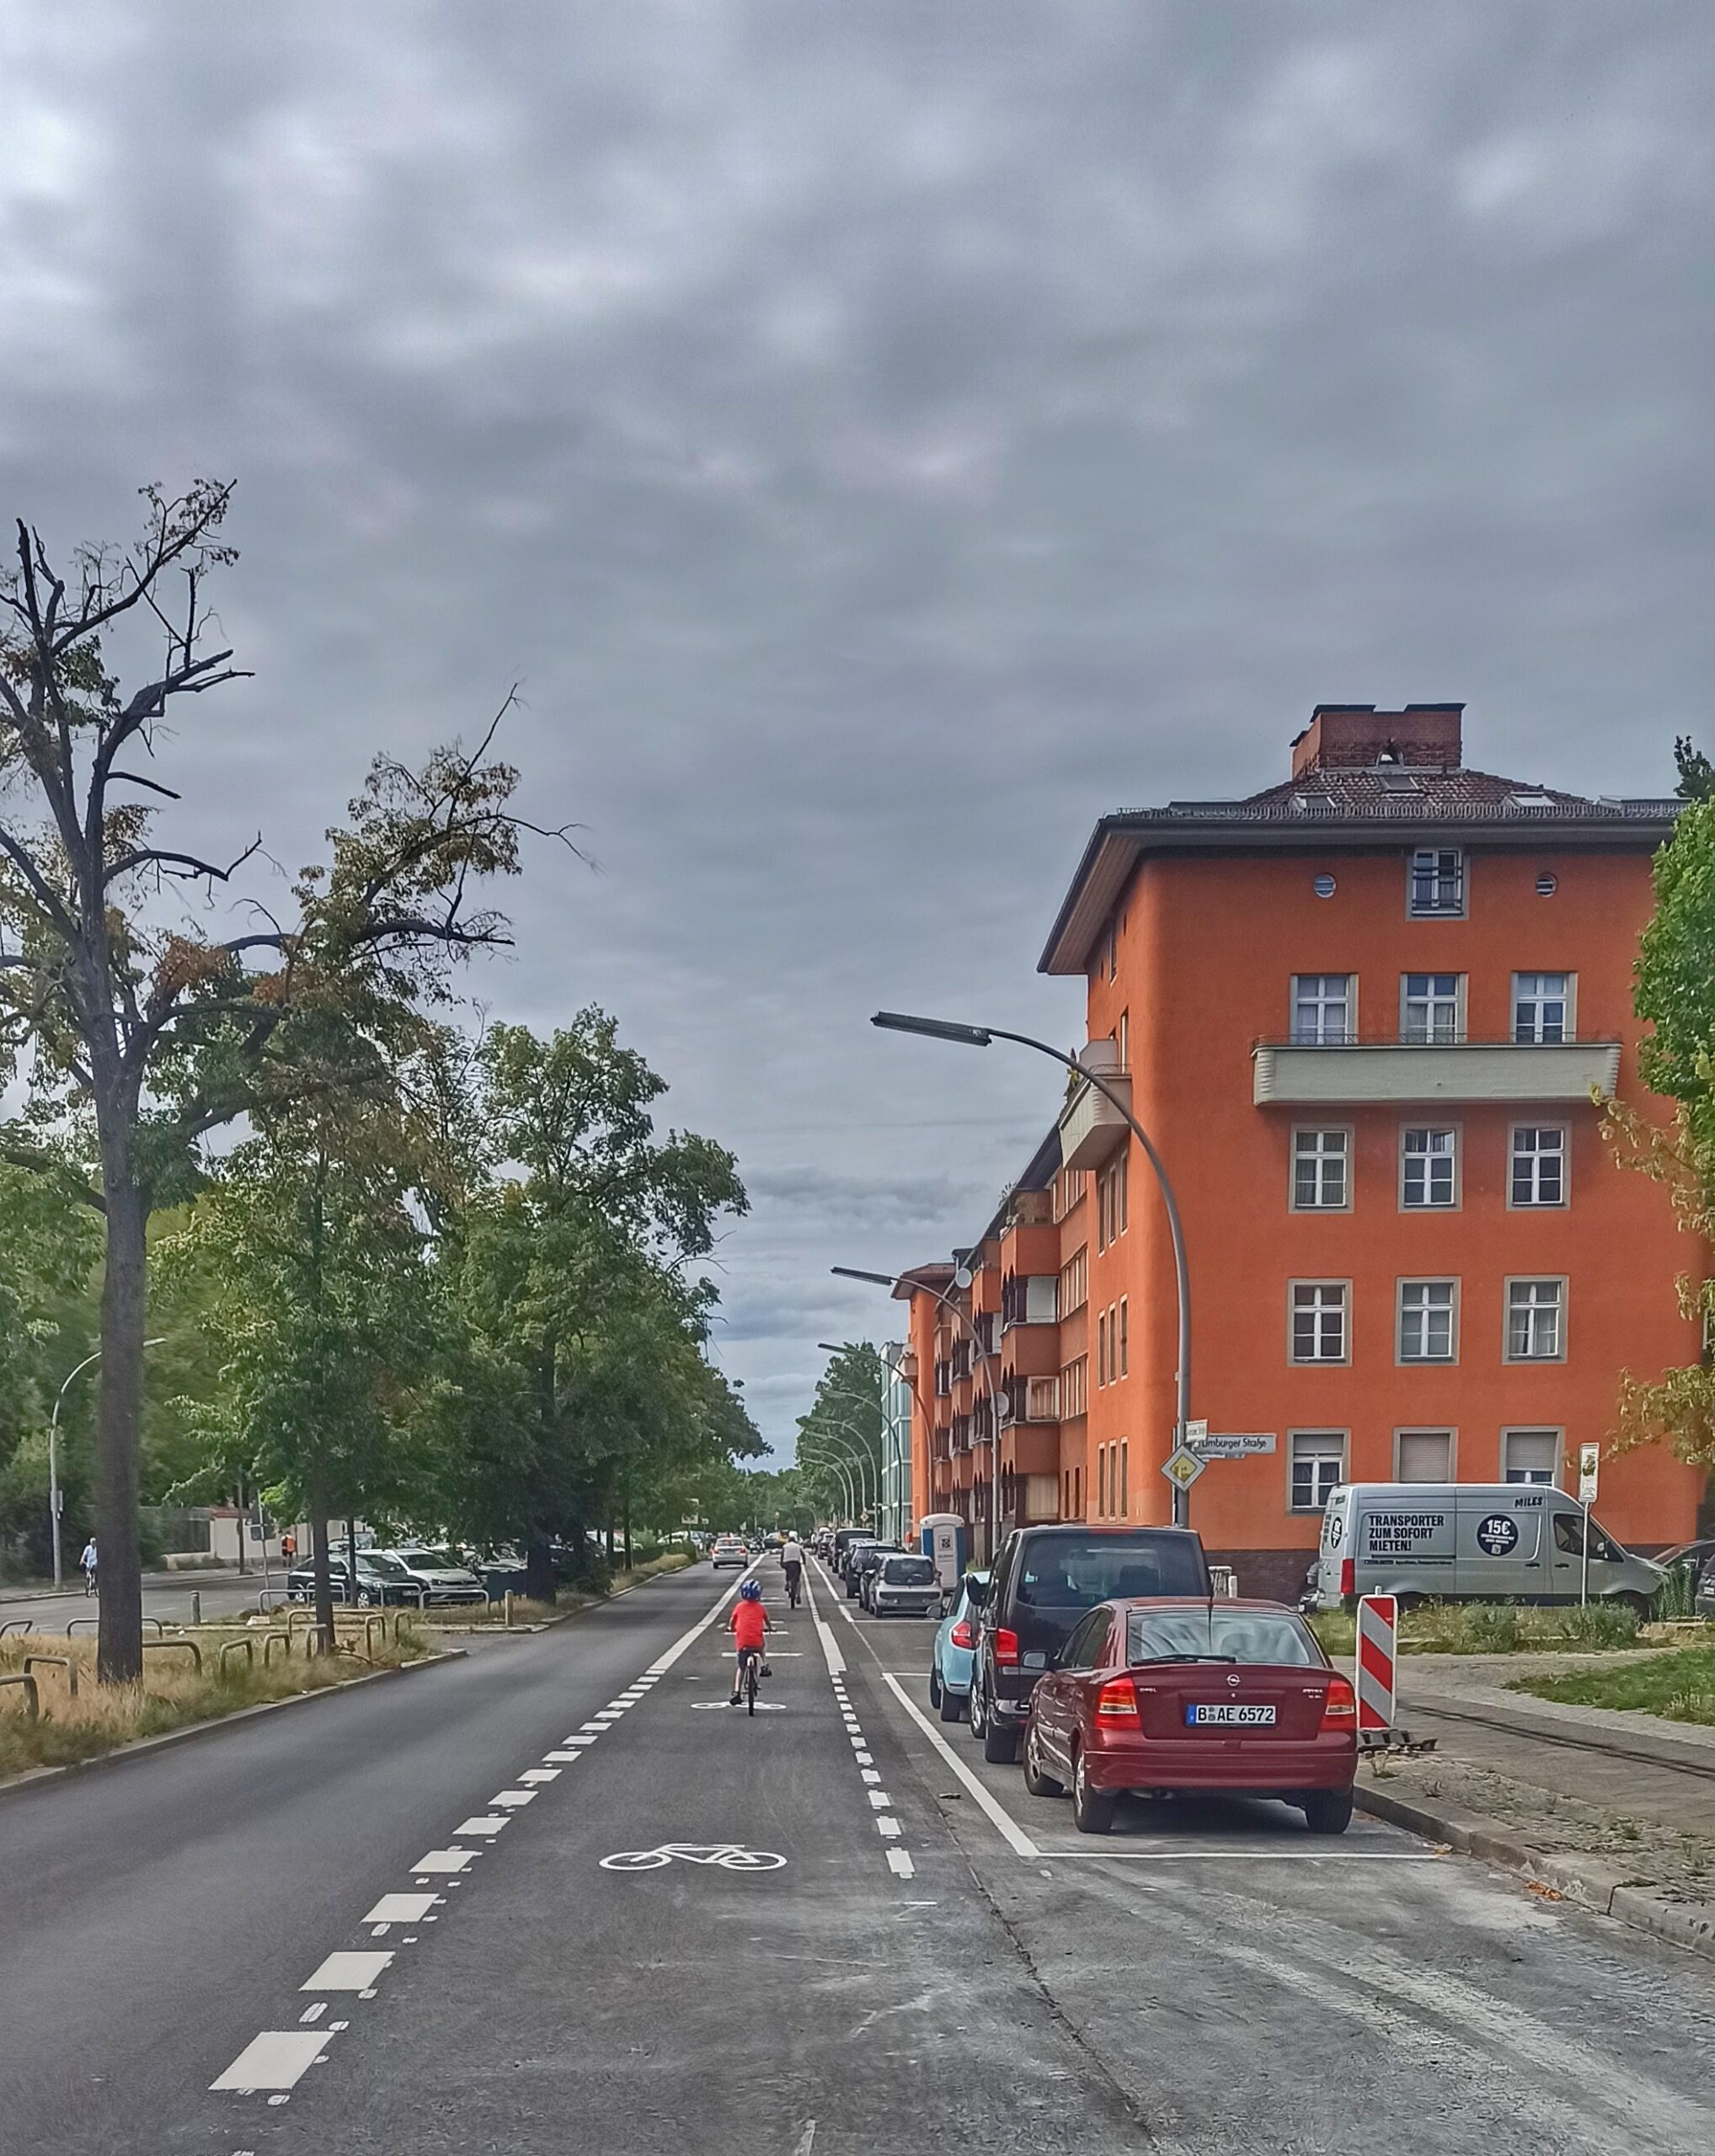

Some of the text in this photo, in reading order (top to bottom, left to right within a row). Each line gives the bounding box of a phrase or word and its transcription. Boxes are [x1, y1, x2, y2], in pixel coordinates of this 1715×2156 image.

[1197, 1438, 1241, 1449] umburger
[1515, 1496, 1543, 1508] MILES
[1369, 1515, 1445, 1526] TRANSPORTER
[1487, 1519, 1511, 1535] 15€
[1369, 1528, 1434, 1539] ZUM SOFORT
[1369, 1540, 1412, 1551] MIETEN!
[1217, 1707, 1235, 1721] AE
[1238, 1707, 1274, 1721] 6572
